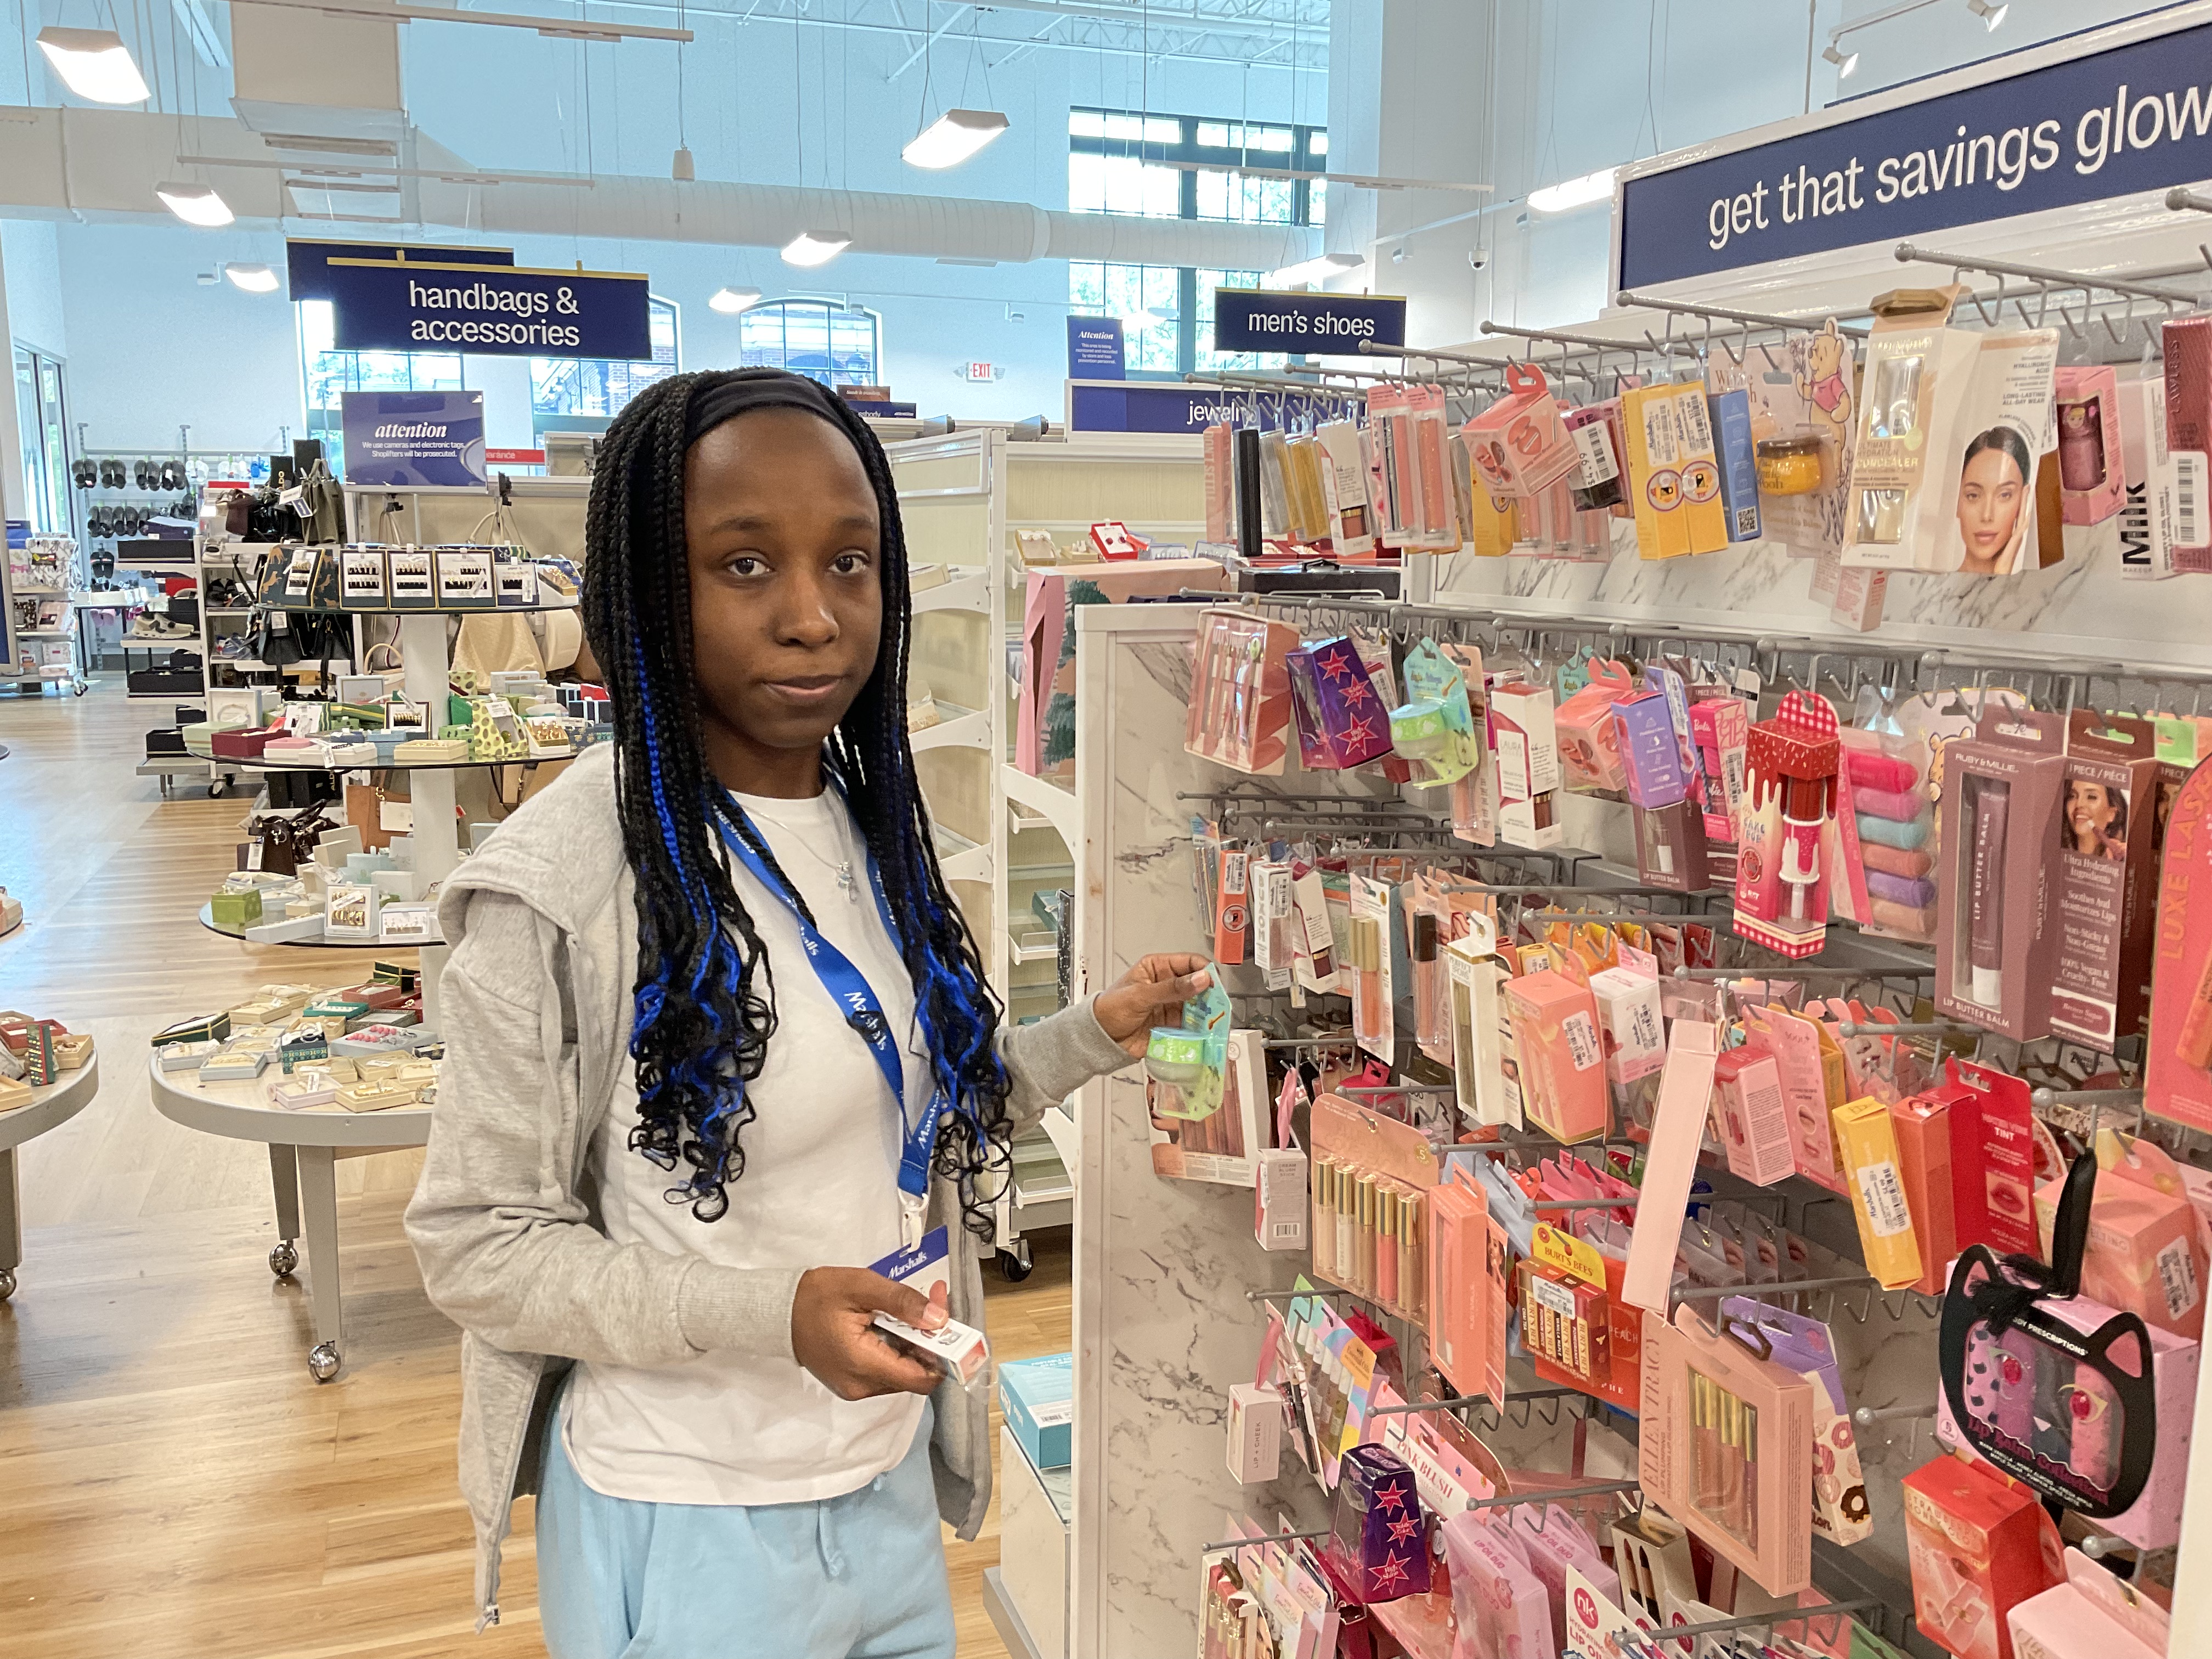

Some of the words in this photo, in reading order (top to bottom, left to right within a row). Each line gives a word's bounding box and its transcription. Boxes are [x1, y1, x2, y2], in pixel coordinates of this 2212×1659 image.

[1709, 180, 1768, 250] get
[1779, 156, 1865, 224] that
[1875, 119, 2061, 204] savings
[2076, 83, 2212, 174] glow
[409, 280, 549, 318] handbags
[556, 287, 579, 314] &
[411, 318, 580, 347] accessories
[1077, 330, 1114, 340] Attention
[1249, 311, 1307, 334] men's
[1314, 313, 1374, 337] shoes
[973, 363, 991, 379] EXIT
[375, 422, 447, 438] attention
[422, 450, 457, 459] prosecuted.
[1856, 458, 1918, 467] CONCEALER
[2120, 481, 2152, 565] Milk
[1975, 852, 1983, 896] BUTTER
[2162, 872, 2190, 961] LUXE
[1943, 997, 1954, 1007] LIP
[1956, 1002, 1985, 1019] BUTTER
[1987, 1013, 2010, 1029] BALM
[1994, 1126, 2015, 1141] TINT
[1864, 1187, 1878, 1219] Marshalls
[888, 1252, 928, 1279] Marshalls
[1545, 1246, 1571, 1266] BURT'S
[1573, 1260, 1593, 1277] BEES
[2028, 1322, 2087, 1356] PRESCRIPTIONS
[1645, 1335, 1660, 1405] TRACY
[1644, 1413, 1659, 1489] ELLEN
[1397, 1441, 1419, 1467] PINK
[1420, 1460, 1453, 1498] BLUSH
[1474, 1539, 1485, 1551] LIP
[1491, 1556, 1505, 1569] DUO
[1548, 1538, 1557, 1547] OIL
[1556, 1545, 1573, 1559] DUO
[1577, 1594, 1594, 1621] nk
[1570, 1627, 1585, 1645] LIP
